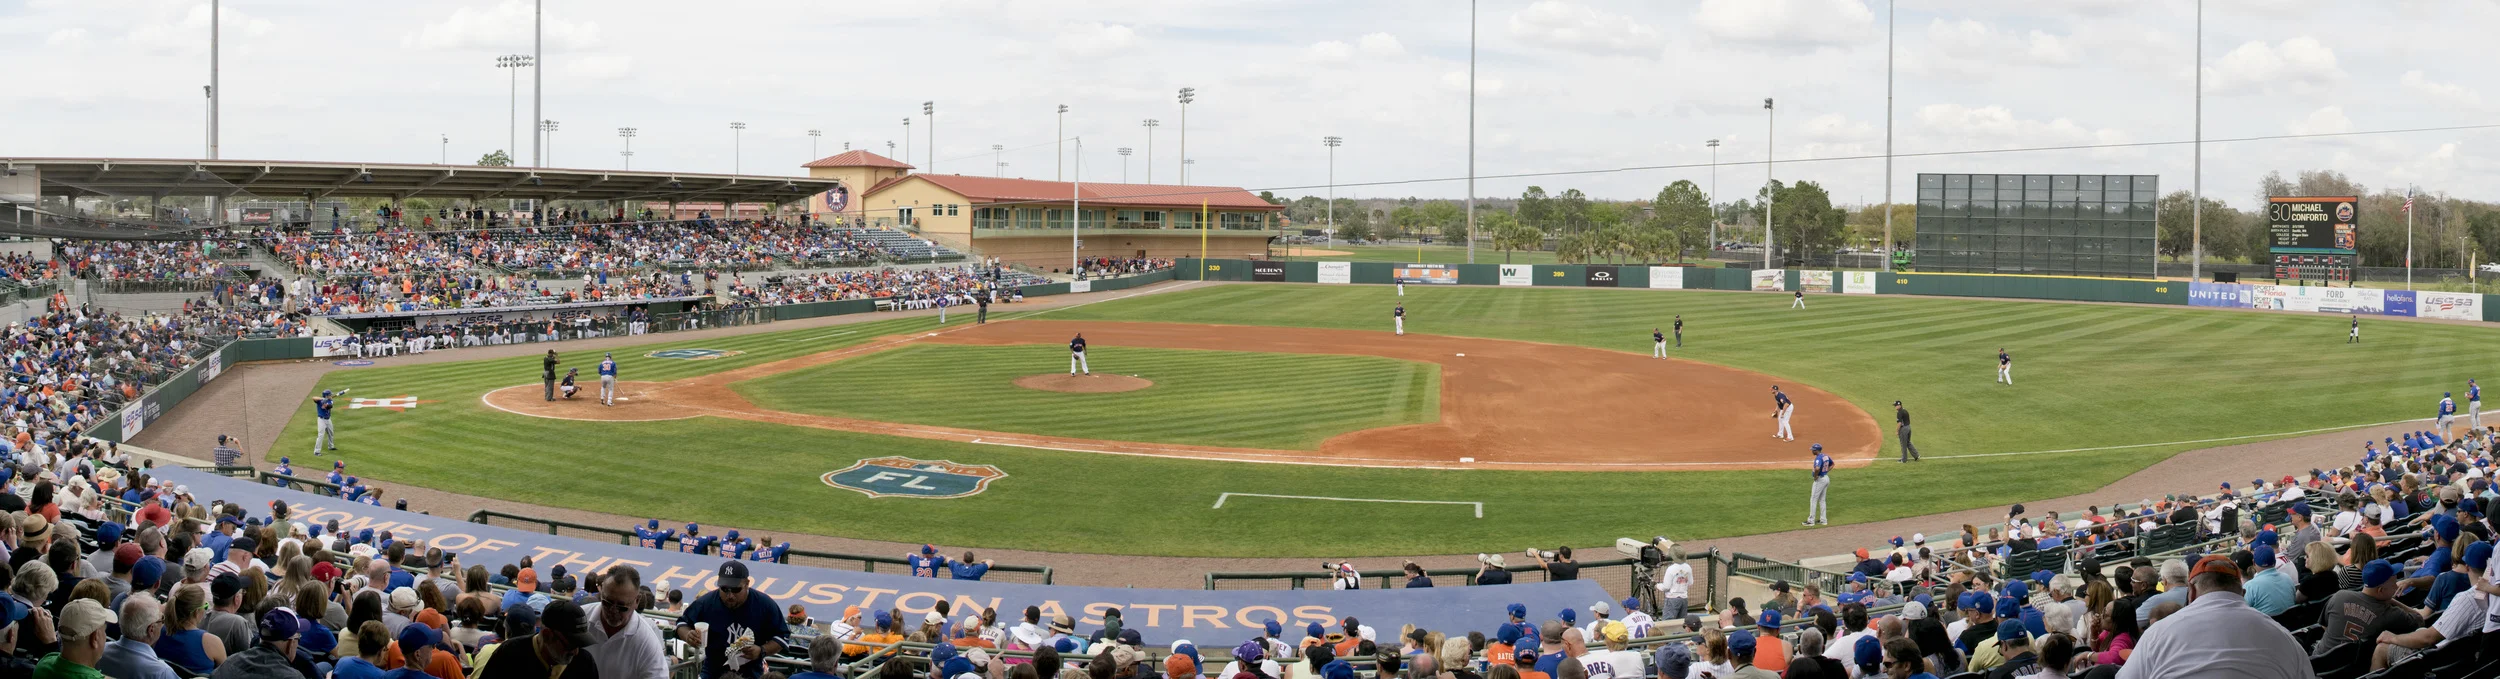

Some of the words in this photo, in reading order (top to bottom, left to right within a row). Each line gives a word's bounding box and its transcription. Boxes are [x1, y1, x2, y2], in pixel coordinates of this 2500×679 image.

[2270, 203, 2291, 221] 30
[2291, 204, 2323, 212] MICHAEL
[2189, 290, 2237, 300] UNITED
[2326, 290, 2344, 299] FORD
[863, 471, 936, 490] FL
[289, 503, 434, 542] HOME
[429, 533, 520, 554] OF
[724, 566, 733, 575] NY
[2343, 602, 2377, 625] WRIGHT
[2343, 620, 2365, 641] 5
